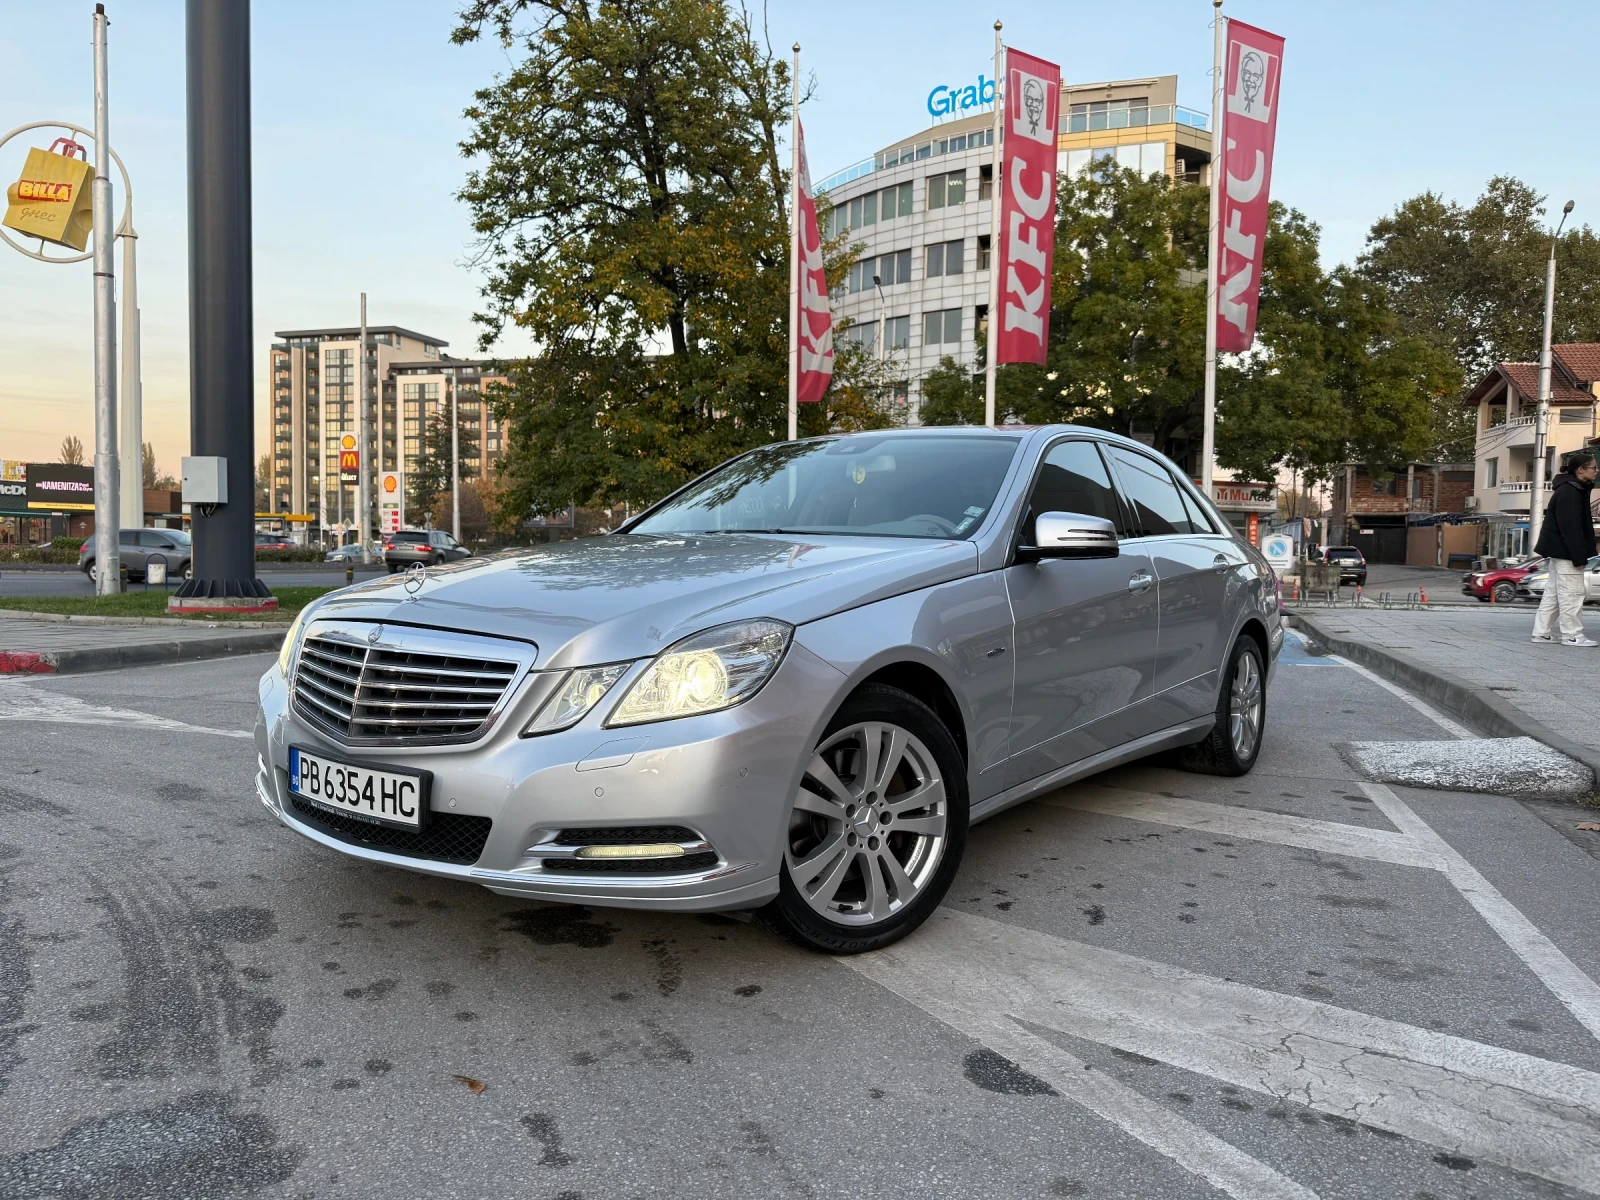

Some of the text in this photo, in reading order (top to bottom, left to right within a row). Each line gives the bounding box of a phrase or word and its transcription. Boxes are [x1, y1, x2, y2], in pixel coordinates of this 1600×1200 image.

[927, 74, 1005, 117] Grab
[20, 182, 70, 201] BILLA
[1005, 156, 1052, 347] KFC
[1218, 137, 1265, 334] KFC
[800, 209, 833, 374] KFC
[42, 481, 79, 491] KAMENITZA
[300, 756, 321, 795] PB
[324, 766, 376, 811] 6354
[381, 777, 416, 818] HC
